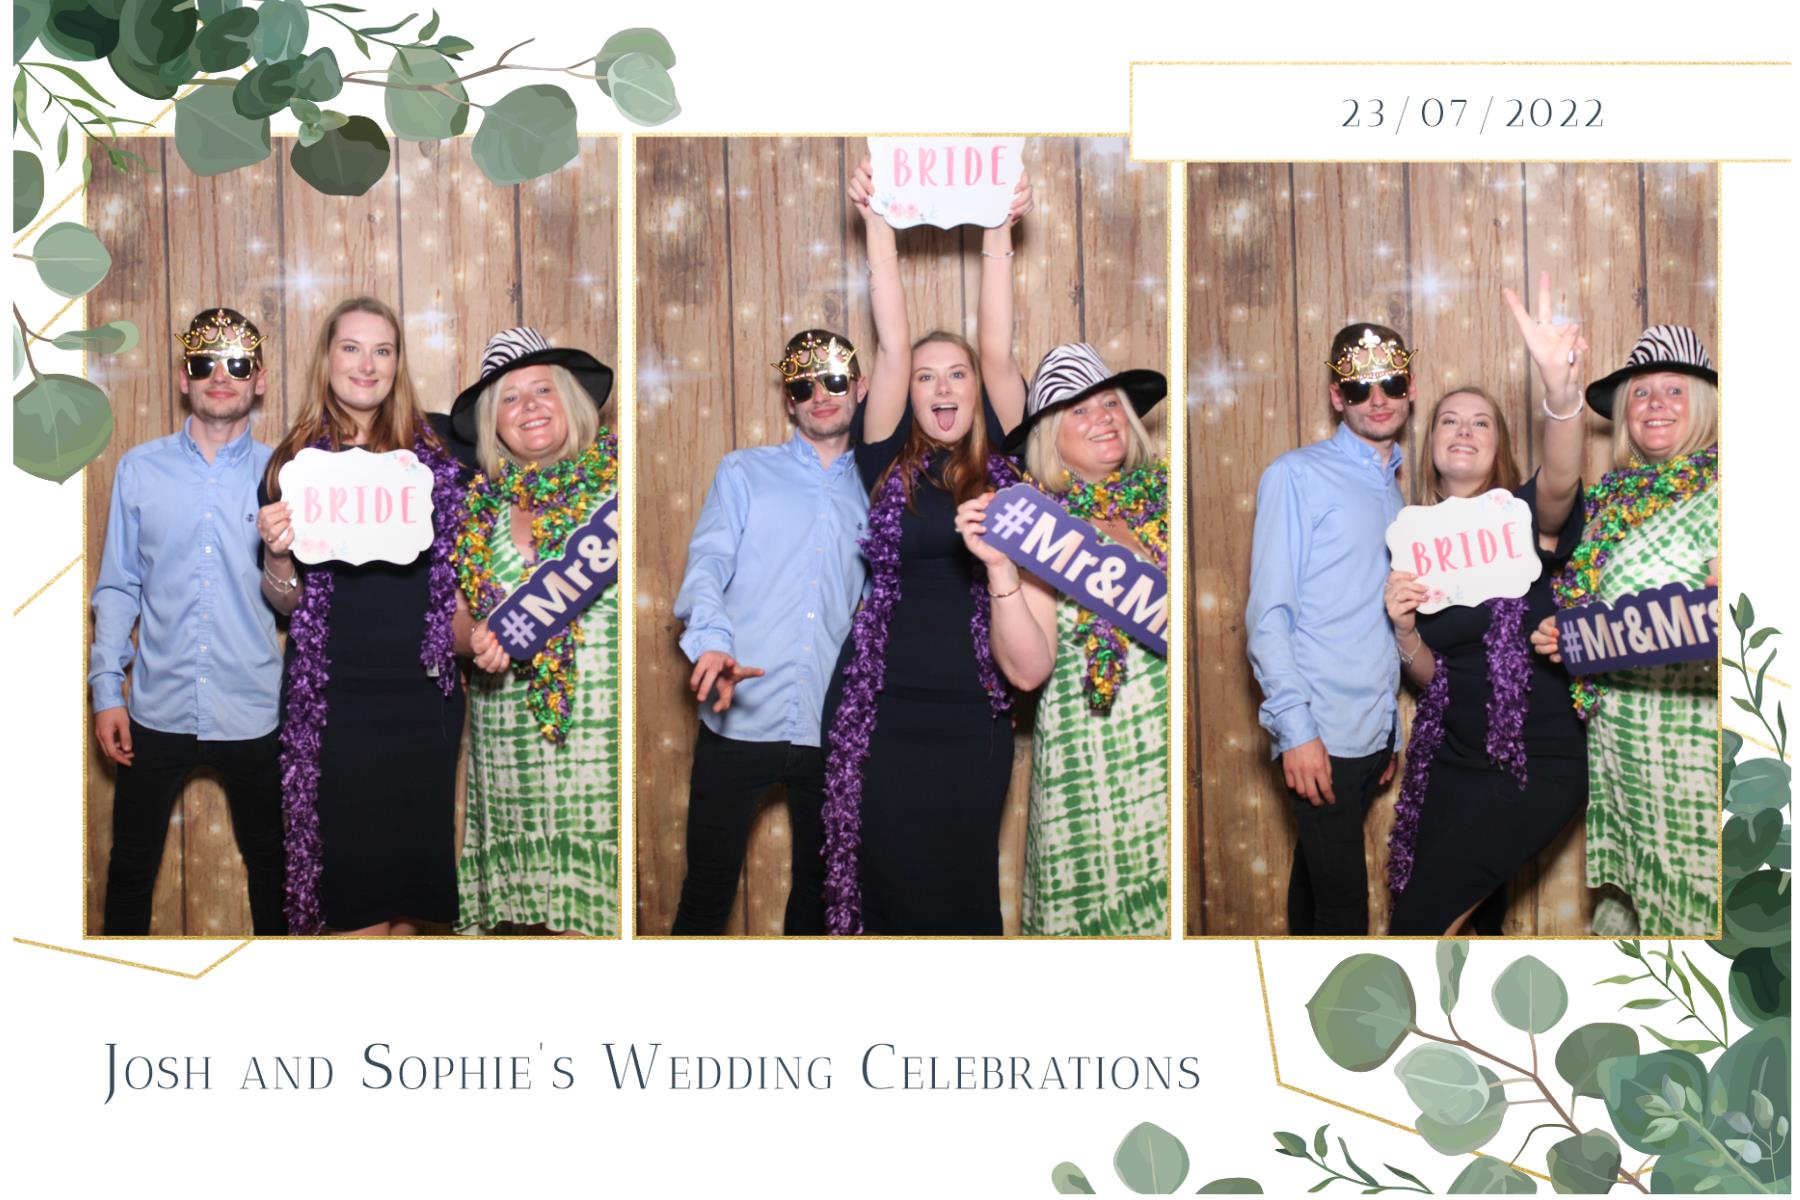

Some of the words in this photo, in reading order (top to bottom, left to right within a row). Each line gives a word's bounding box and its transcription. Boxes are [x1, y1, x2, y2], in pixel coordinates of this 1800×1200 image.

[892, 144, 1008, 188] BRIDE
[303, 485, 418, 525] BRIDE
[991, 497, 1168, 642] #Mr&M
[1410, 521, 1523, 577] BRIDE
[501, 510, 618, 650] #Mr&
